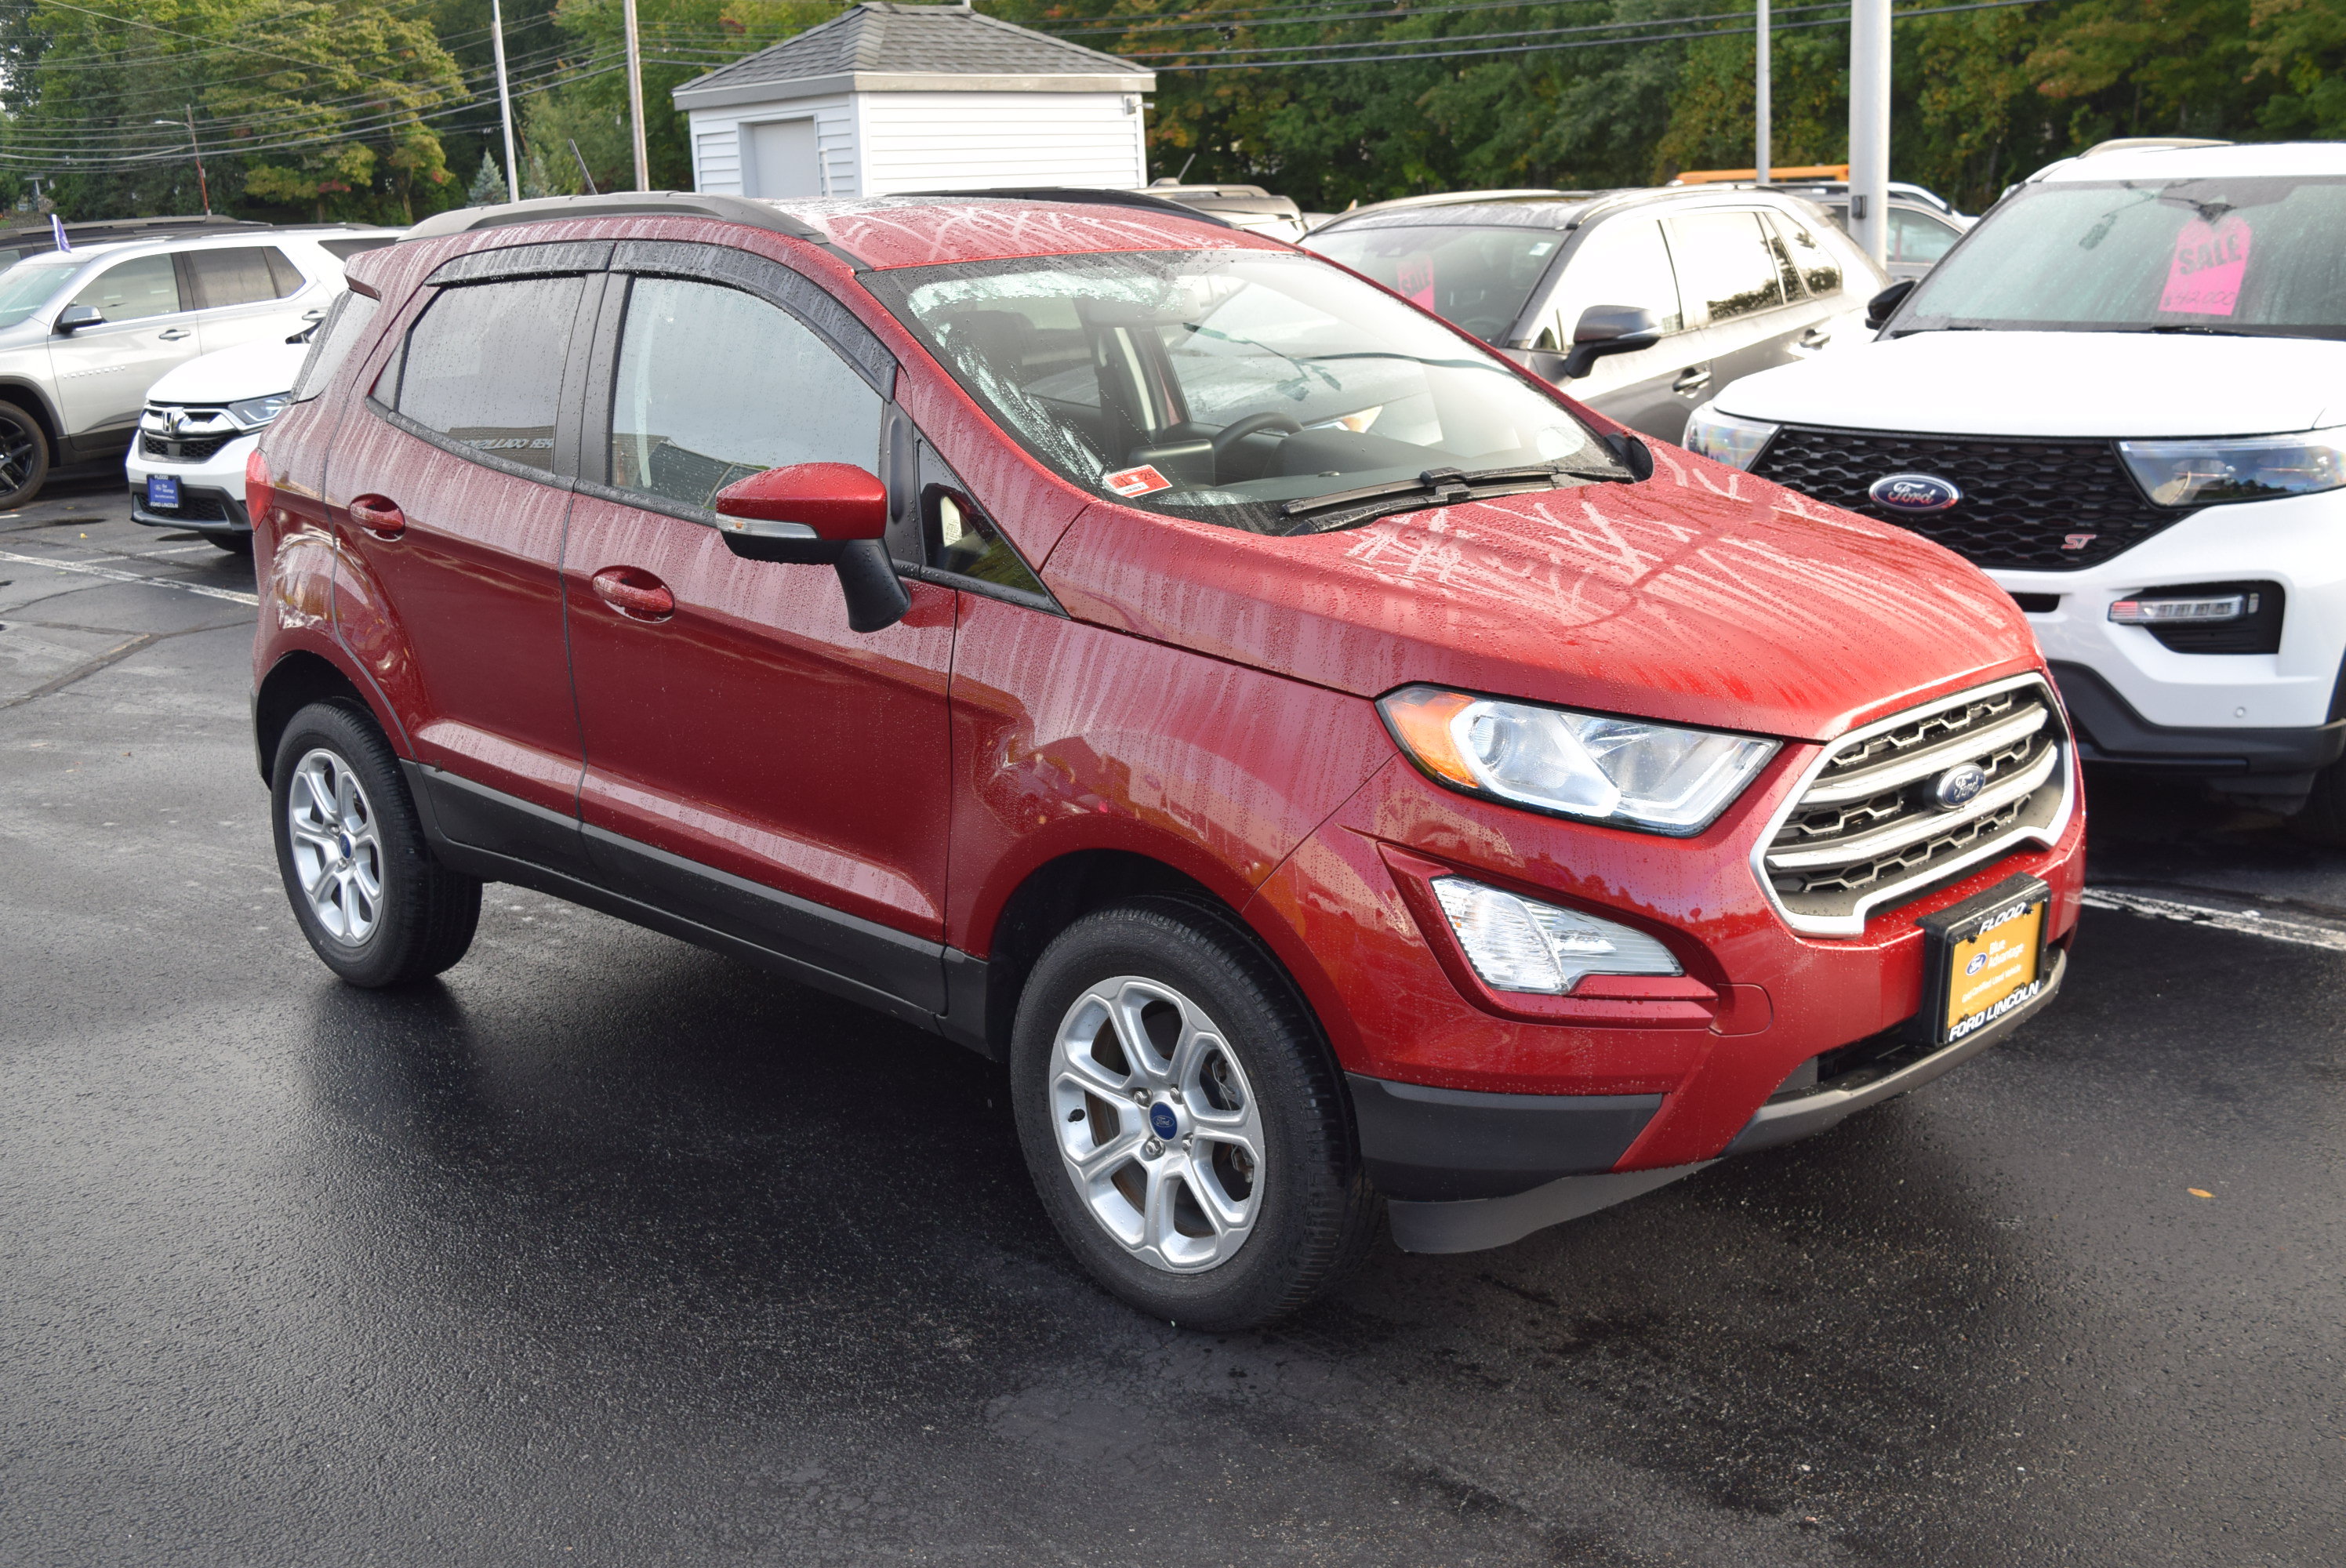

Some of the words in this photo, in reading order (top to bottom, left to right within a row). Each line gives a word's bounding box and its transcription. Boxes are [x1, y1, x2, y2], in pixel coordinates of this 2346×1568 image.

[2177, 234, 2242, 275] SALE
[1140, 470, 1157, 481] 26
[1887, 481, 1937, 503] Ford
[2061, 534, 2097, 549] ST
[1953, 772, 1979, 801] Ford
[1979, 902, 2026, 935] FLOOD
[1988, 943, 2025, 969] Advantage
[1989, 939, 2006, 955] Blue
[1949, 1011, 1985, 1042] FORD
[1986, 980, 2040, 1019] LINCOLN
[1156, 1116, 1170, 1126] Ford
